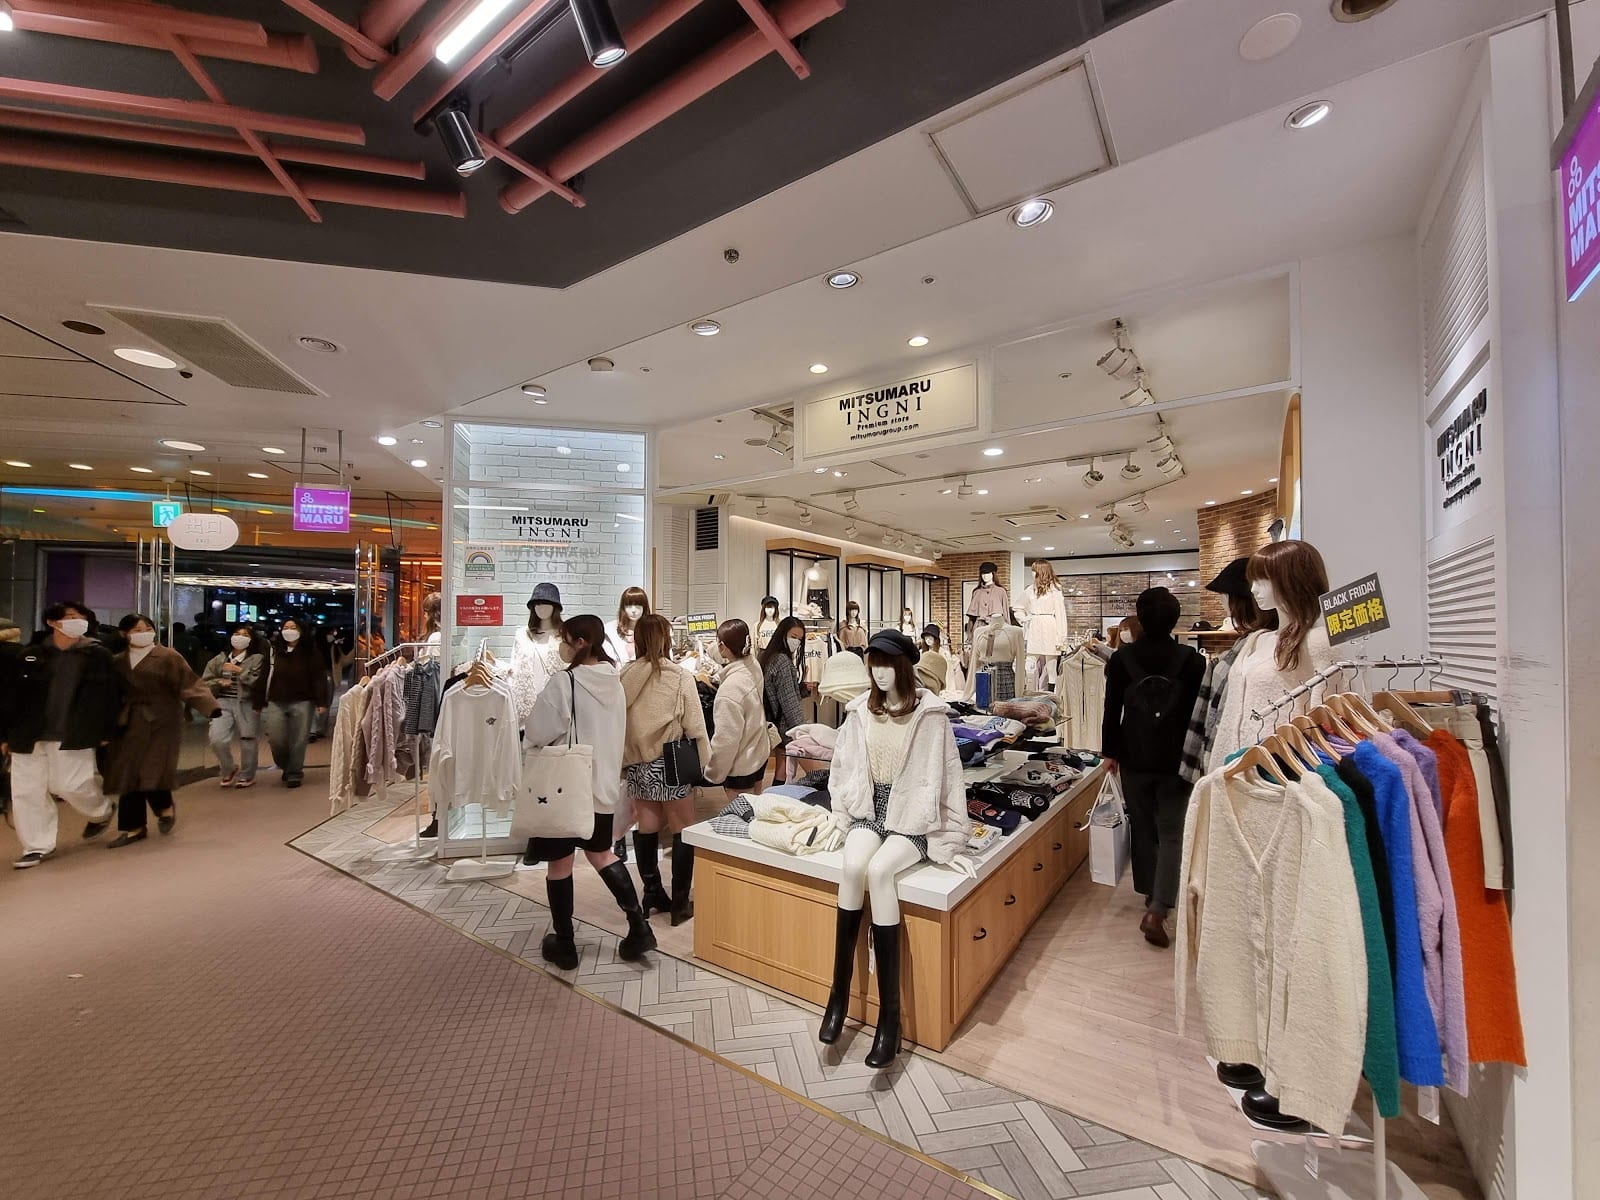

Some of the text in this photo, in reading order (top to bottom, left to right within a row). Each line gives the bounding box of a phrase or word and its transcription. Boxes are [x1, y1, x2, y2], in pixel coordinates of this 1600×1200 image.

[1570, 200, 1600, 268] MA
[839, 379, 931, 411] MITSUMARU
[846, 396, 923, 426] INGNI
[857, 415, 910, 431] Premium store
[850, 423, 919, 441] mitsumarugroup.com
[300, 504, 344, 514] MITSU
[185, 518, 222, 534] 出口
[300, 513, 344, 525] MARU
[511, 516, 589, 527] MITSUMARU
[518, 526, 582, 538] INGNI
[1323, 580, 1376, 611] BLACK FRIDAY
[1326, 598, 1384, 636] 限定価格
